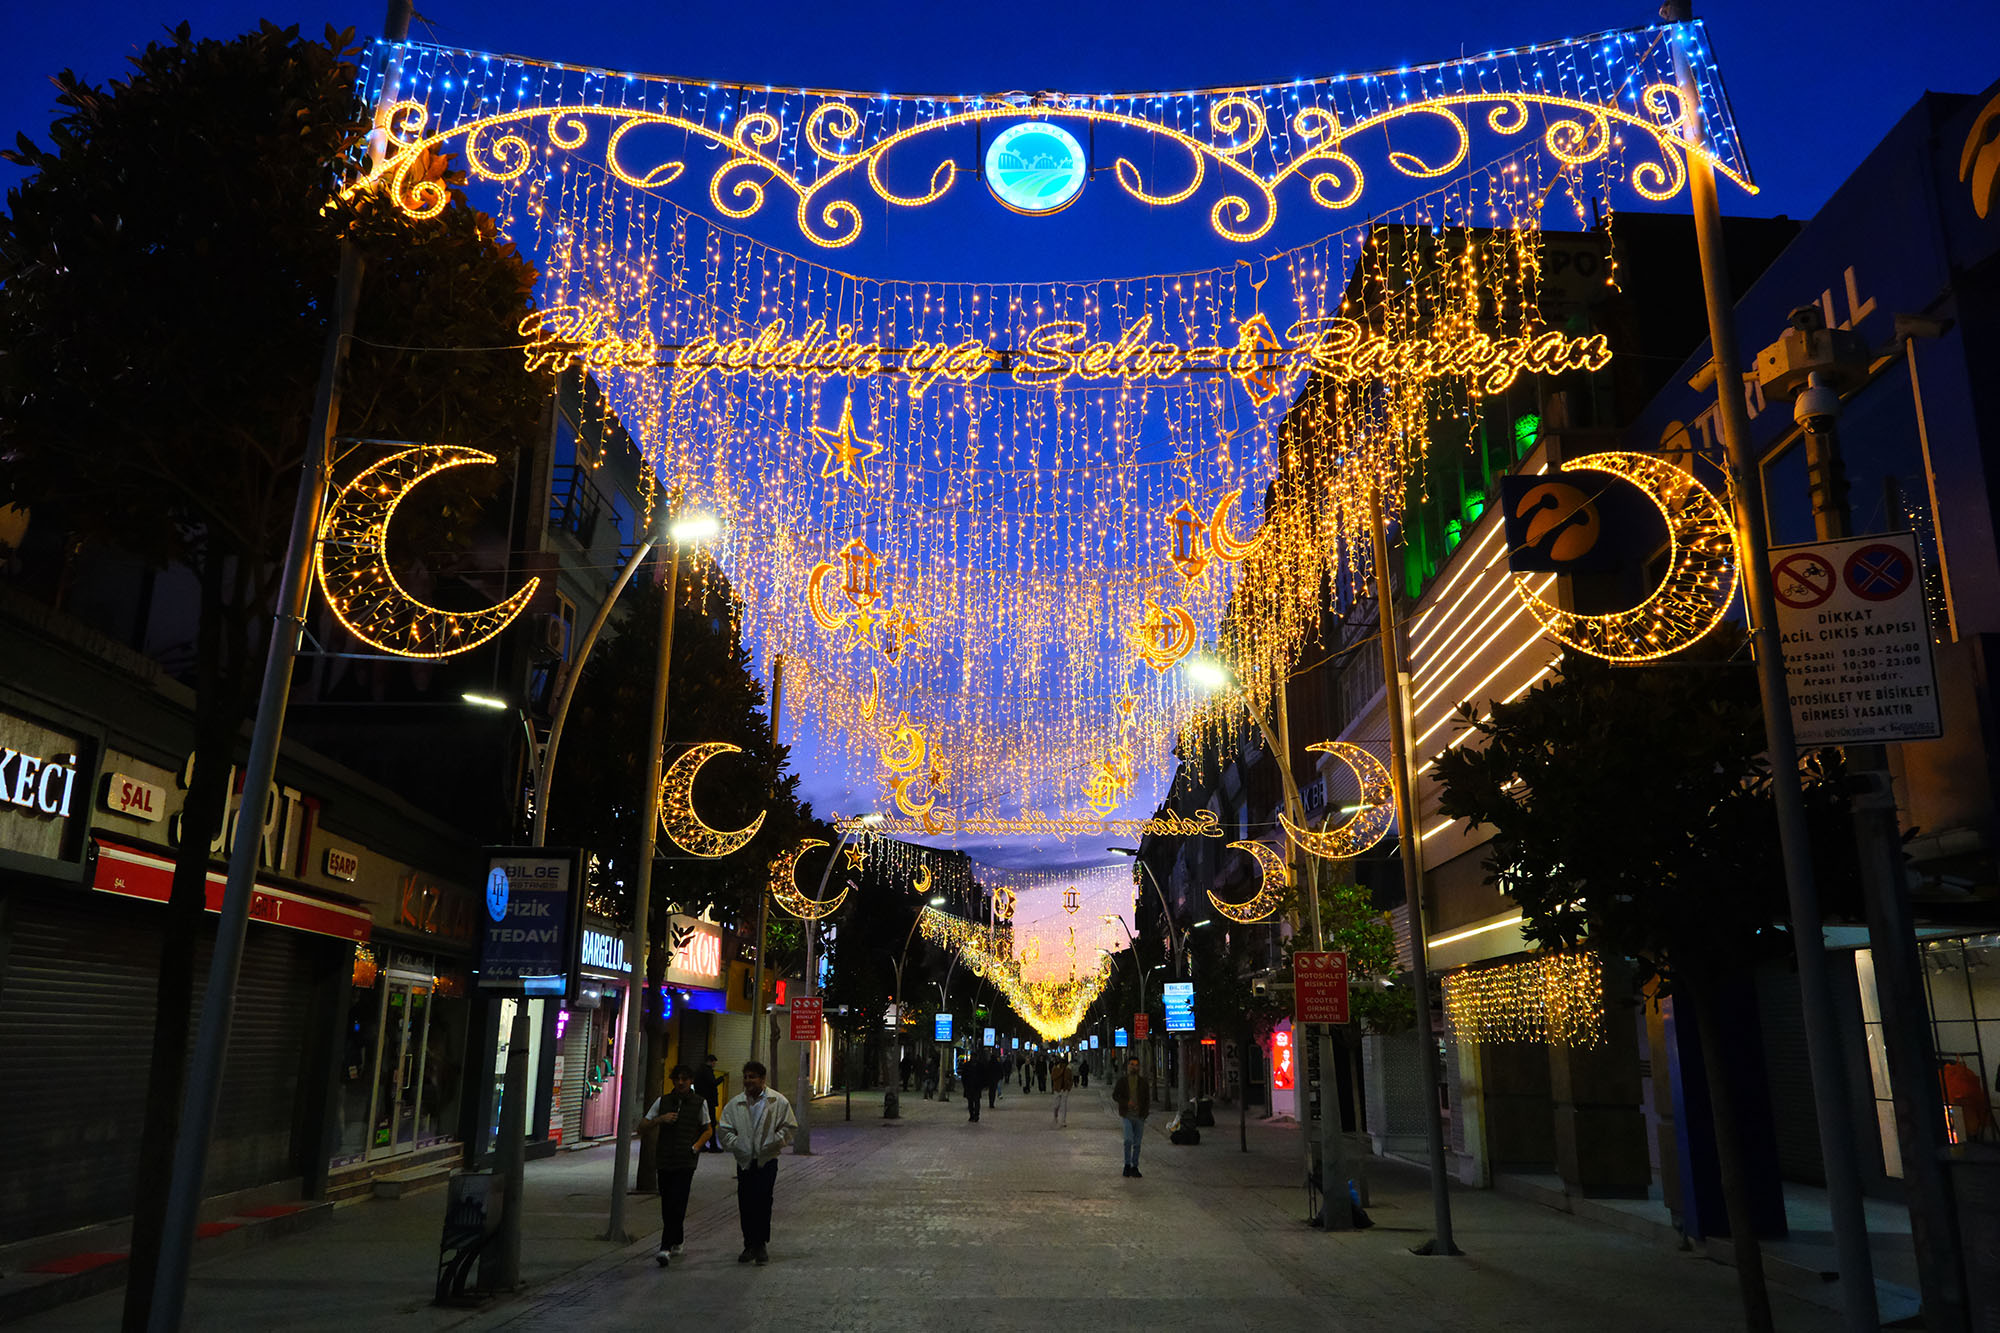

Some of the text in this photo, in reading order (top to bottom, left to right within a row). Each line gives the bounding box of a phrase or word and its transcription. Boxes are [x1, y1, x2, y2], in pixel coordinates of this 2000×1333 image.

[673, 317, 881, 395] geldin
[902, 337, 992, 398] ya
[1284, 317, 1614, 395] Ramazan
[1818, 609, 1873, 625] DİKKAT
[1782, 621, 1917, 644] ACİL ÇIKIŞ KAPISI
[1804, 676, 1836, 687] Arası
[1790, 684, 1931, 707] OTOSİKLET VE BİSİKLET
[1802, 703, 1913, 722] GİRMESİ YASAKTIR
[120, 782, 153, 812] ŞAL
[329, 853, 356, 877] EŞARP
[489, 925, 558, 943] TEDAVİ
[581, 929, 624, 971] BARGELLO
